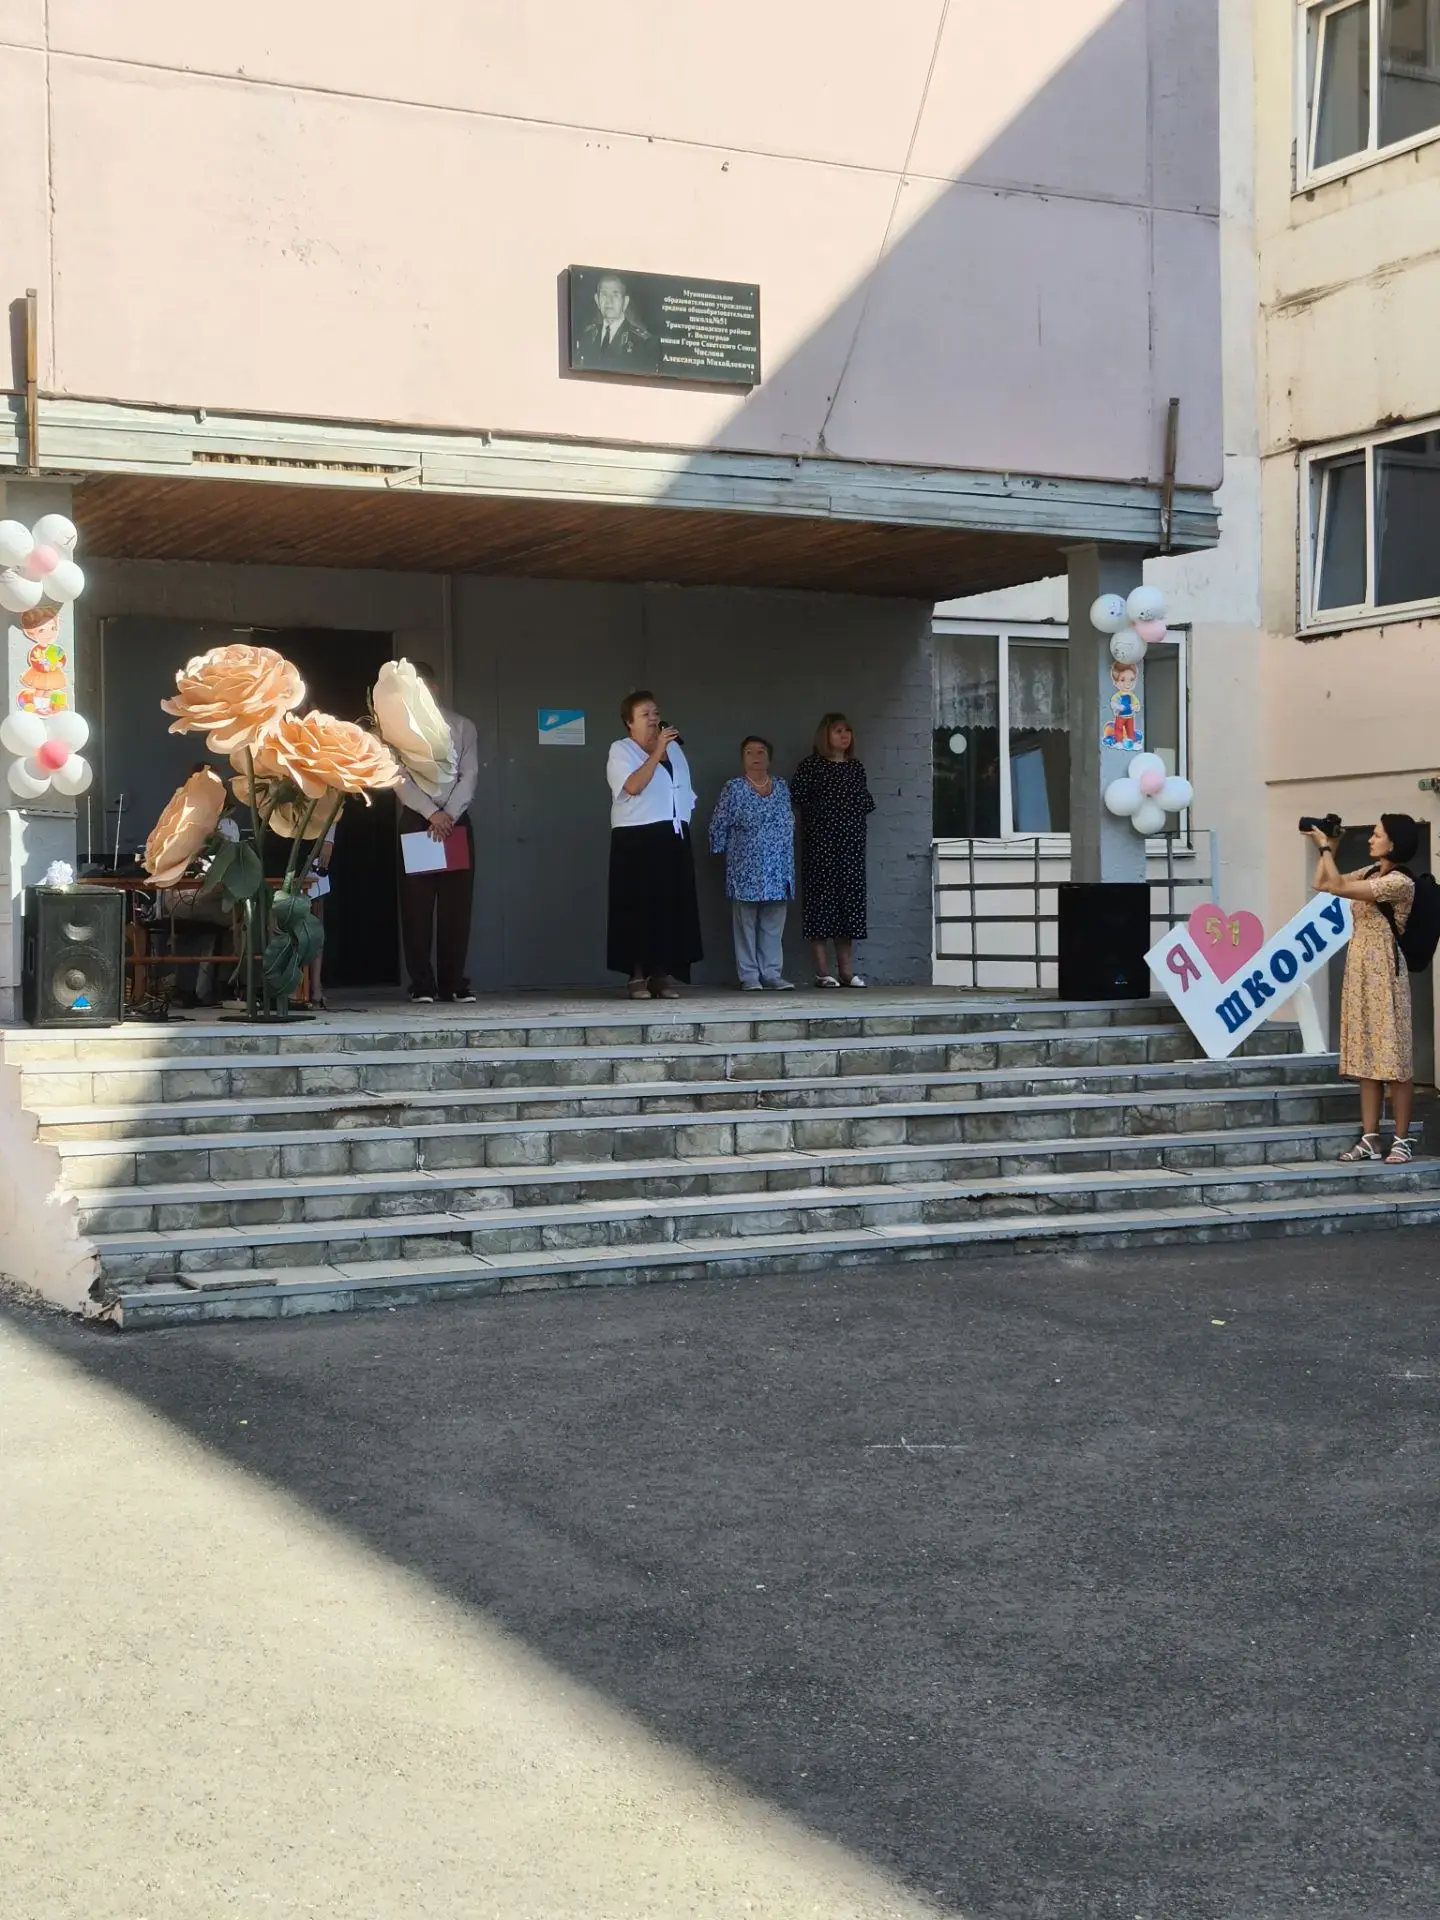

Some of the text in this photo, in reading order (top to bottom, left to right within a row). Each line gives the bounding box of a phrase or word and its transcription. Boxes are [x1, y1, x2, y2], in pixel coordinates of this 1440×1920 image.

[681, 338, 700, 348] Героя
[701, 340, 736, 350] Советского
[737, 344, 756, 352] Союза
[694, 332, 730, 342] Волгограда
[662, 354, 754, 370] Александра Михайловича
[1205, 917, 1240, 947] 51
[1166, 943, 1202, 993] Я
[1215, 897, 1345, 1033] ШКОЛУ
